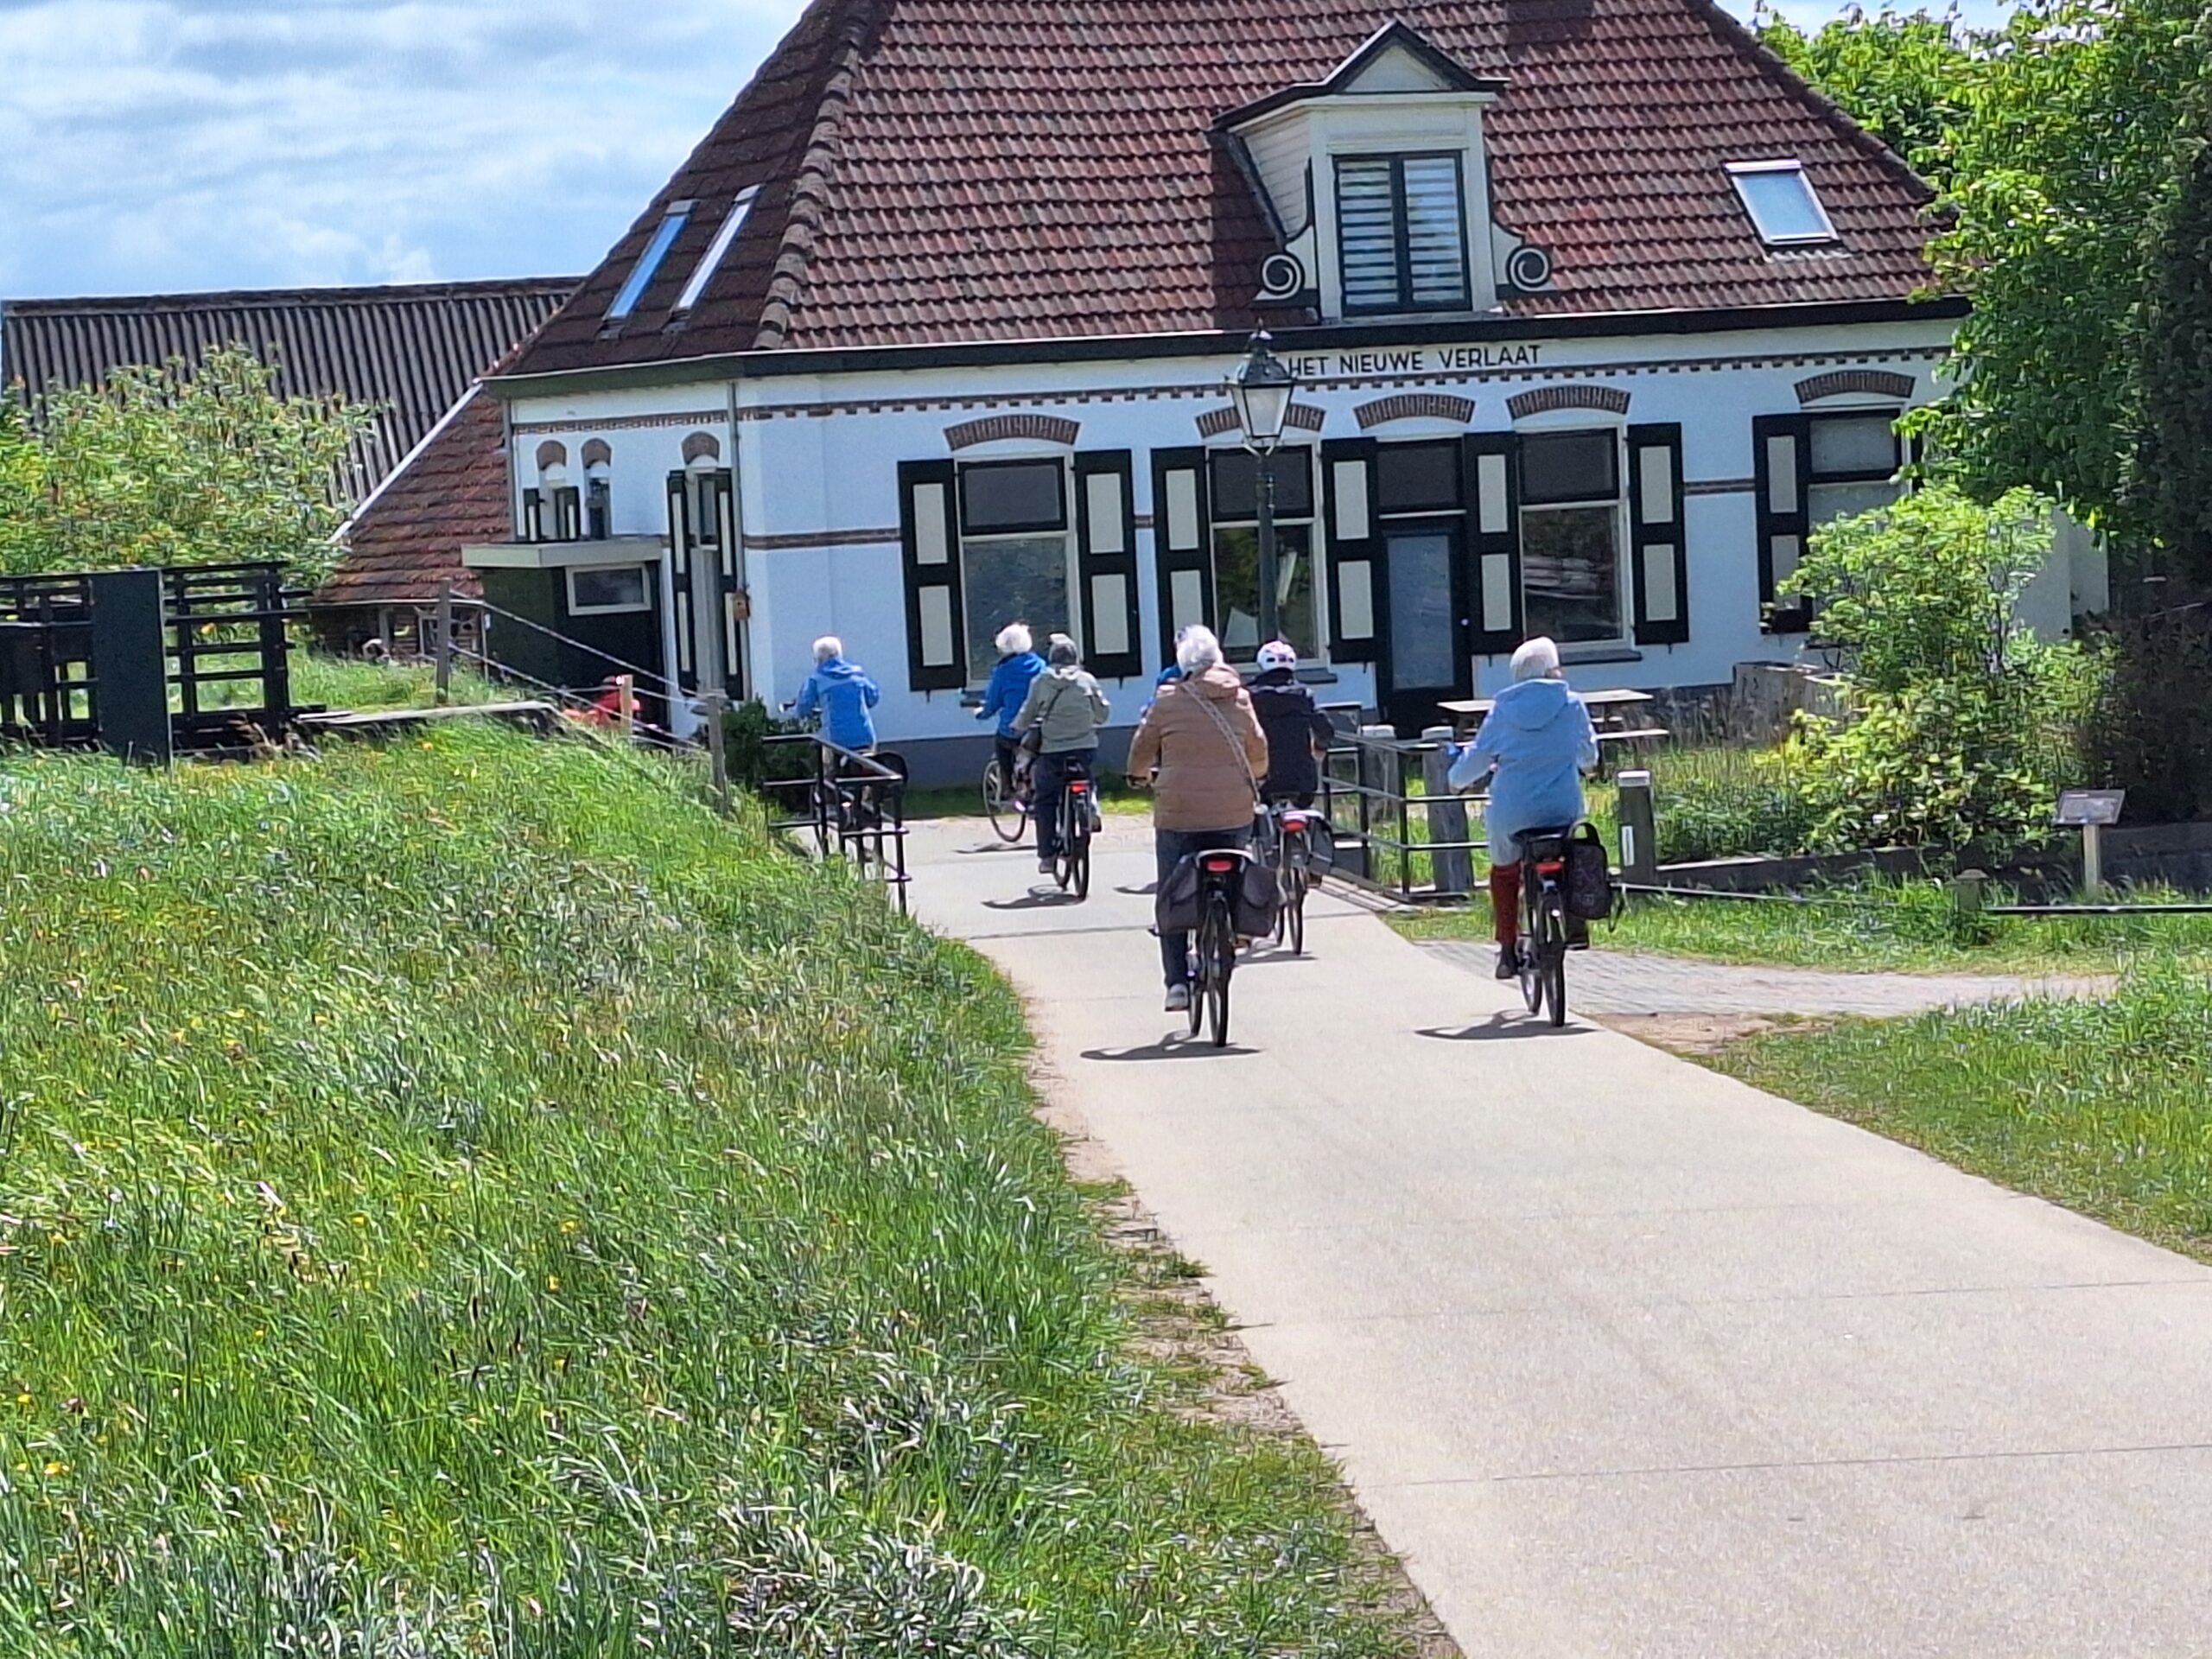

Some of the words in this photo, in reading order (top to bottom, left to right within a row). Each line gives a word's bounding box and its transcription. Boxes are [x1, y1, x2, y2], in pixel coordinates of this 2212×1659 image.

[1288, 356, 1329, 375] HET
[1339, 351, 1423, 374] NIEUWE
[1438, 345, 1541, 368] VERLAAT
